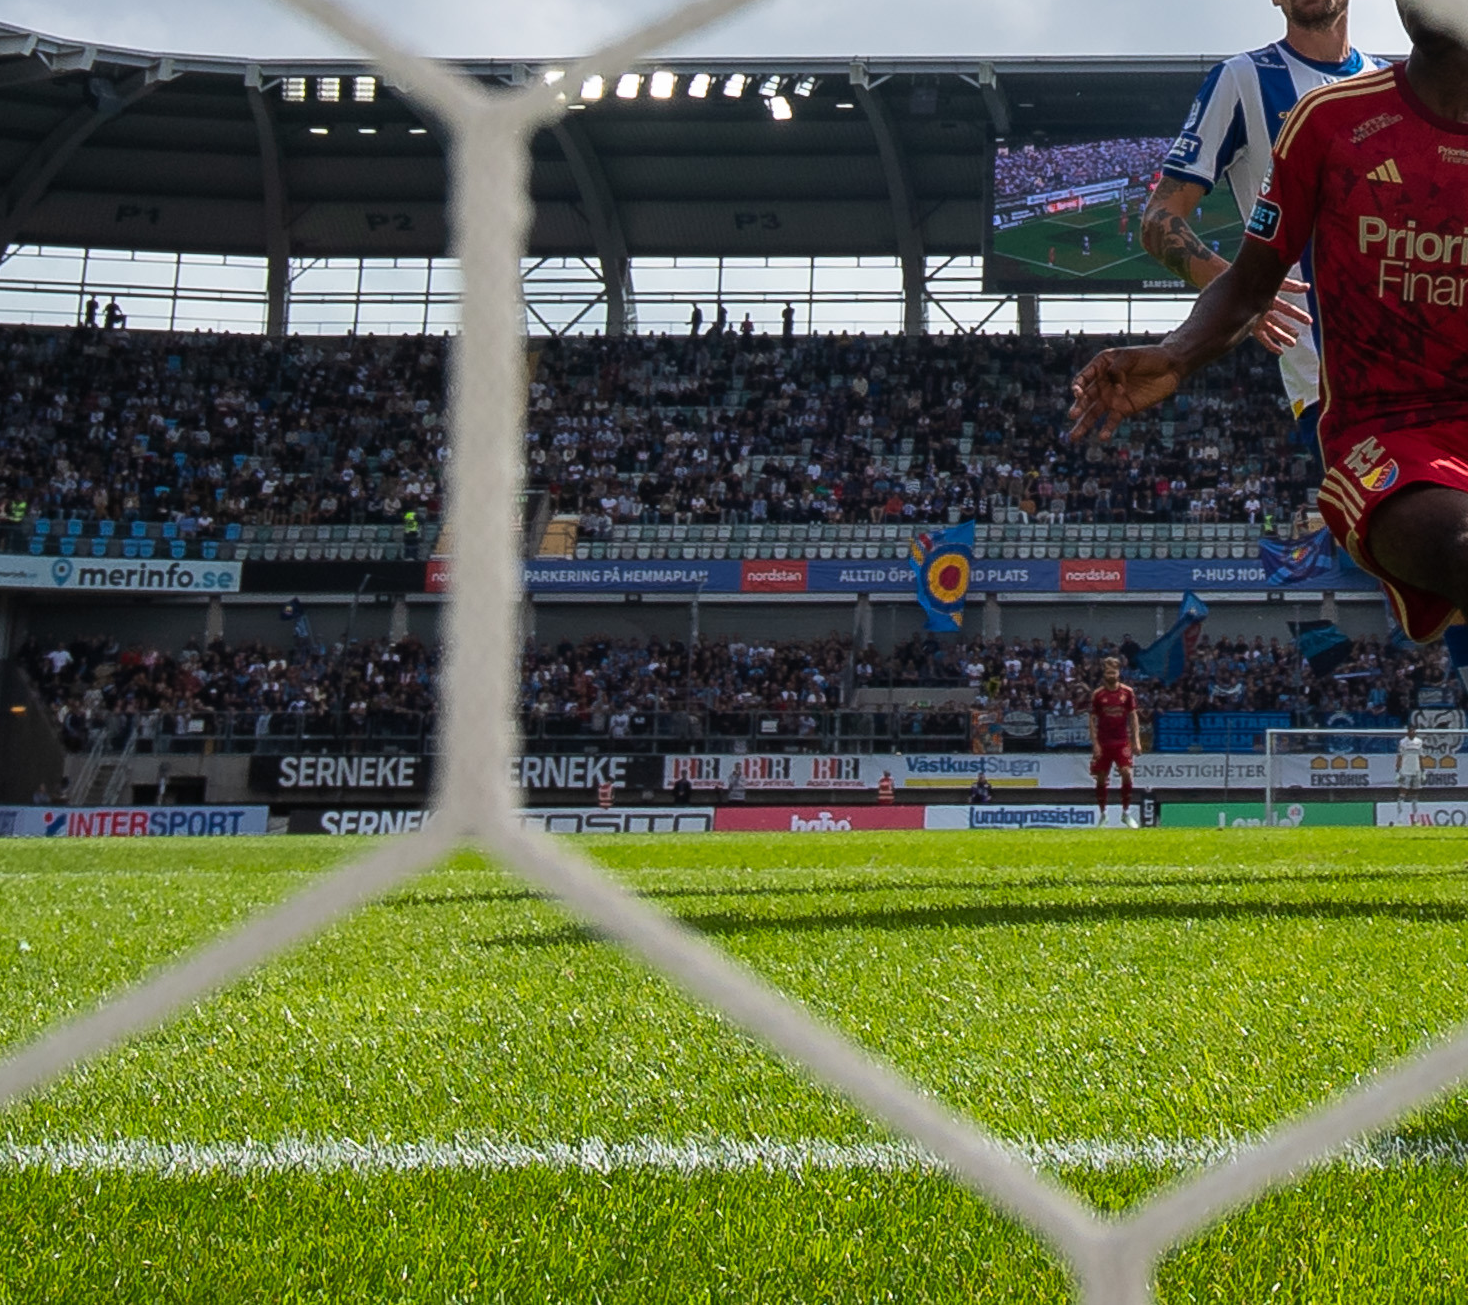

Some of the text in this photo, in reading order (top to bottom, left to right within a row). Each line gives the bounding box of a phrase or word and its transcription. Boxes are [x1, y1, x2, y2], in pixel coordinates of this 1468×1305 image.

[78, 562, 235, 589] merinfo.se
[524, 565, 709, 584] PARKERING PÅ HEMMAPLAN
[746, 569, 802, 582] nordstan
[839, 569, 886, 583] ALLTID
[987, 569, 1029, 584] PLATS
[1065, 569, 1121, 582] nordstan
[1192, 569, 1236, 583] P-HUS
[277, 755, 416, 788] SERNEKE
[506, 755, 629, 789] ERNEKE
[905, 755, 1041, 776] VästkustStugan
[1310, 771, 1370, 787] EKSJÖHUS
[67, 810, 244, 837] INTERSPORT
